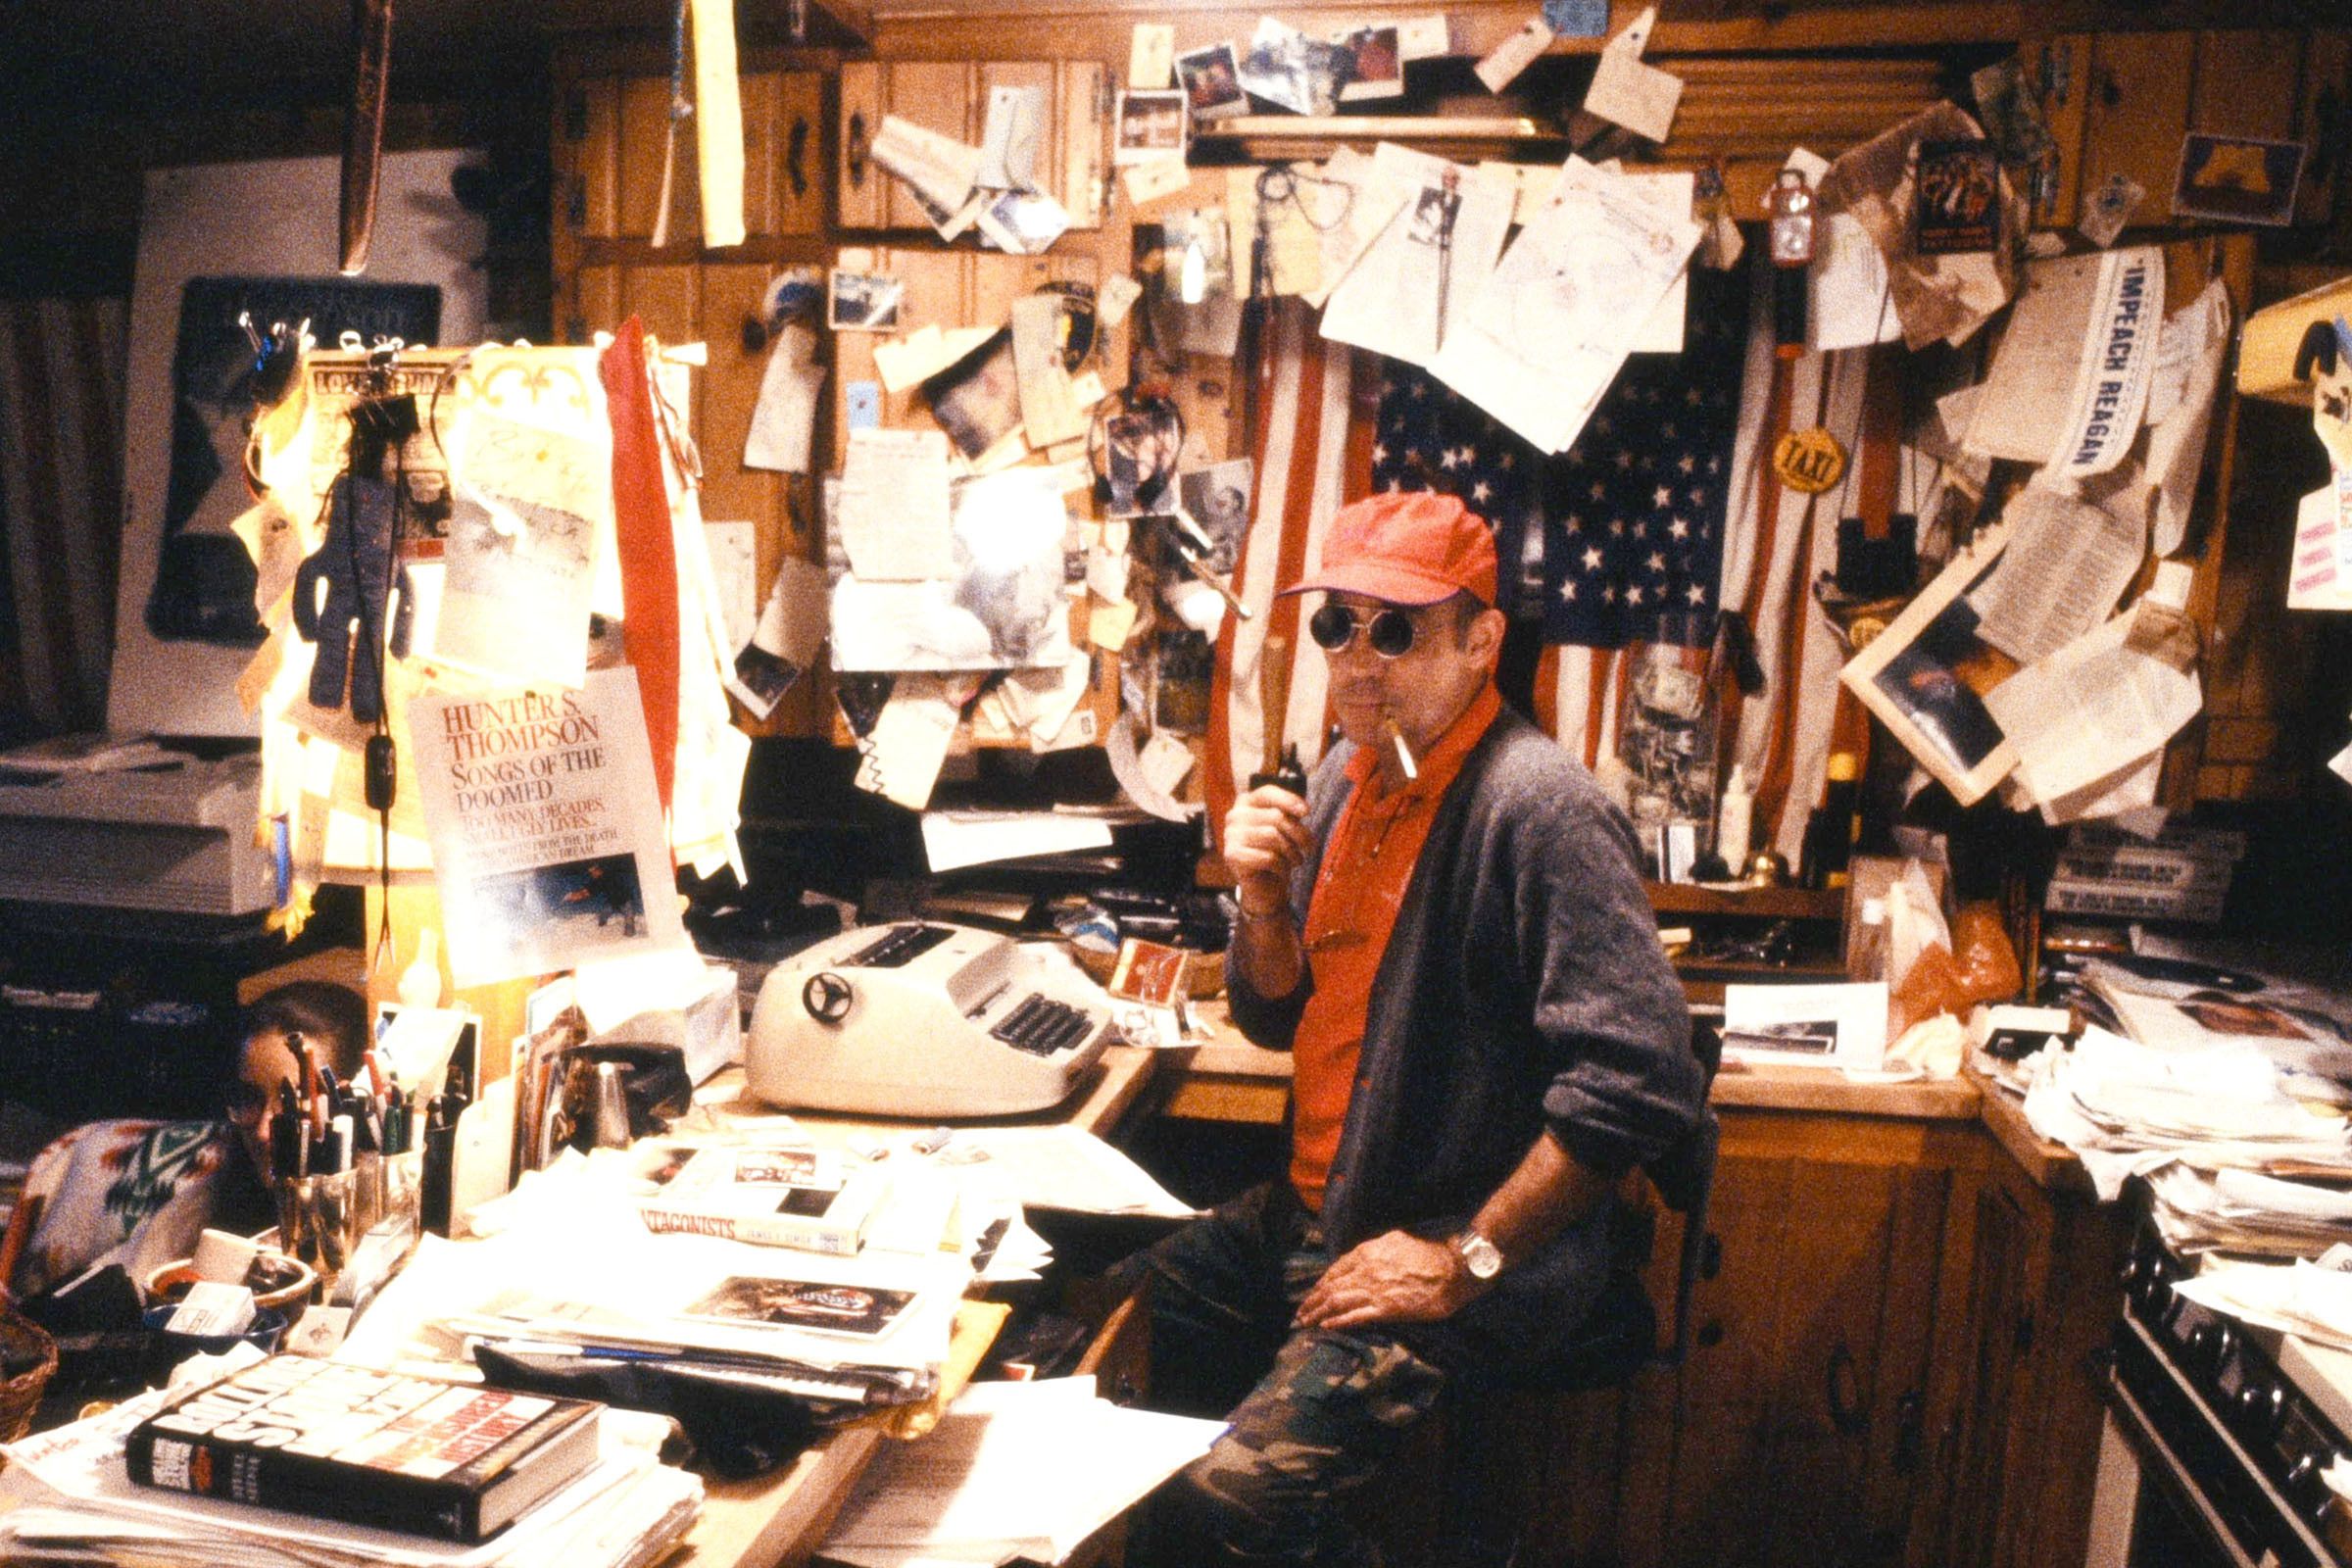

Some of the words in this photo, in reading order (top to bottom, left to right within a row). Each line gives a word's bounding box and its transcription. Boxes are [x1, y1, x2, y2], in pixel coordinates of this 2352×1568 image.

[2104, 267, 2146, 371] IMPEACH
[2073, 381, 2123, 465] REAGAN
[1783, 439, 1837, 482] TAXI
[443, 695, 557, 733] HUNTER
[446, 715, 600, 760] THOMPSON
[452, 759, 525, 790] SONGS
[530, 754, 558, 777] OF
[561, 747, 606, 772] THE
[457, 779, 553, 812] DOOMED
